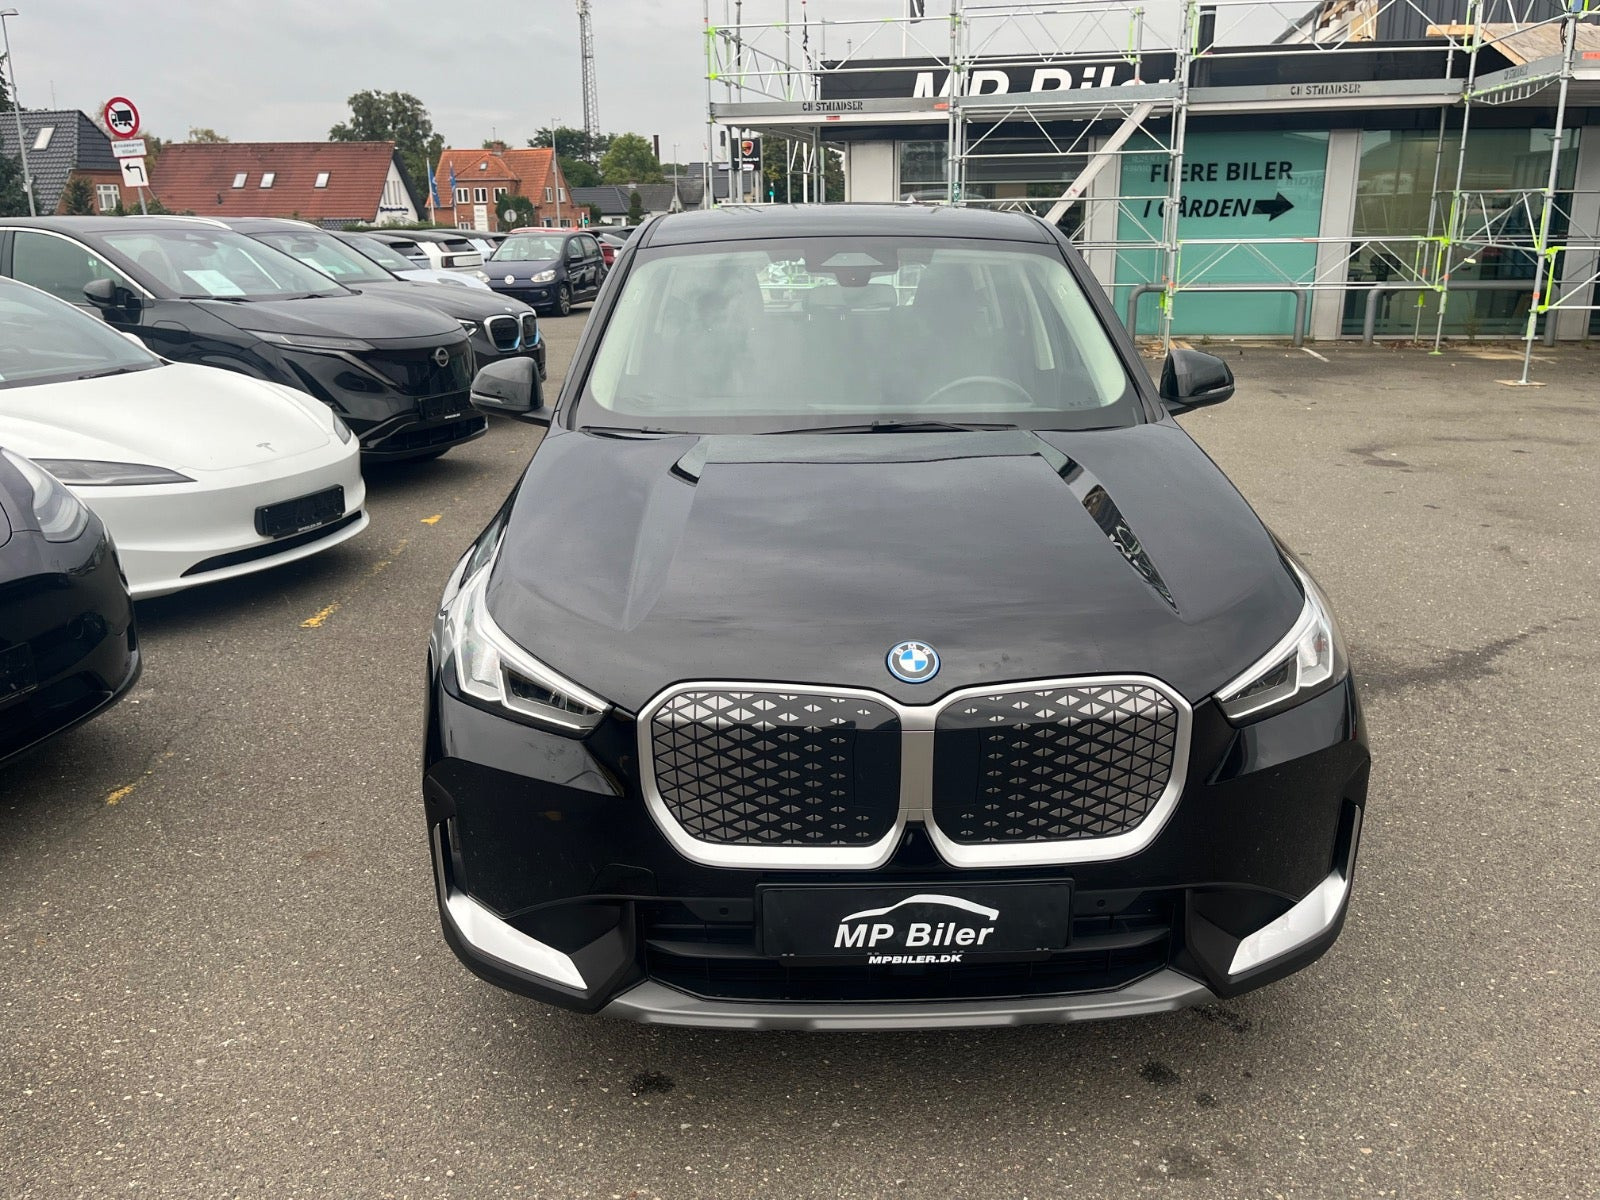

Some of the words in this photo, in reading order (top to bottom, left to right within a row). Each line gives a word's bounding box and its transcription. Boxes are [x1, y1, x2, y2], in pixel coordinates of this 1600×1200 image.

[1226, 161, 1293, 181] BILER
[1143, 200, 1152, 218] I
[834, 923, 895, 948] MP
[905, 922, 995, 947] Biler
[868, 954, 963, 964] MPBILER.DK
